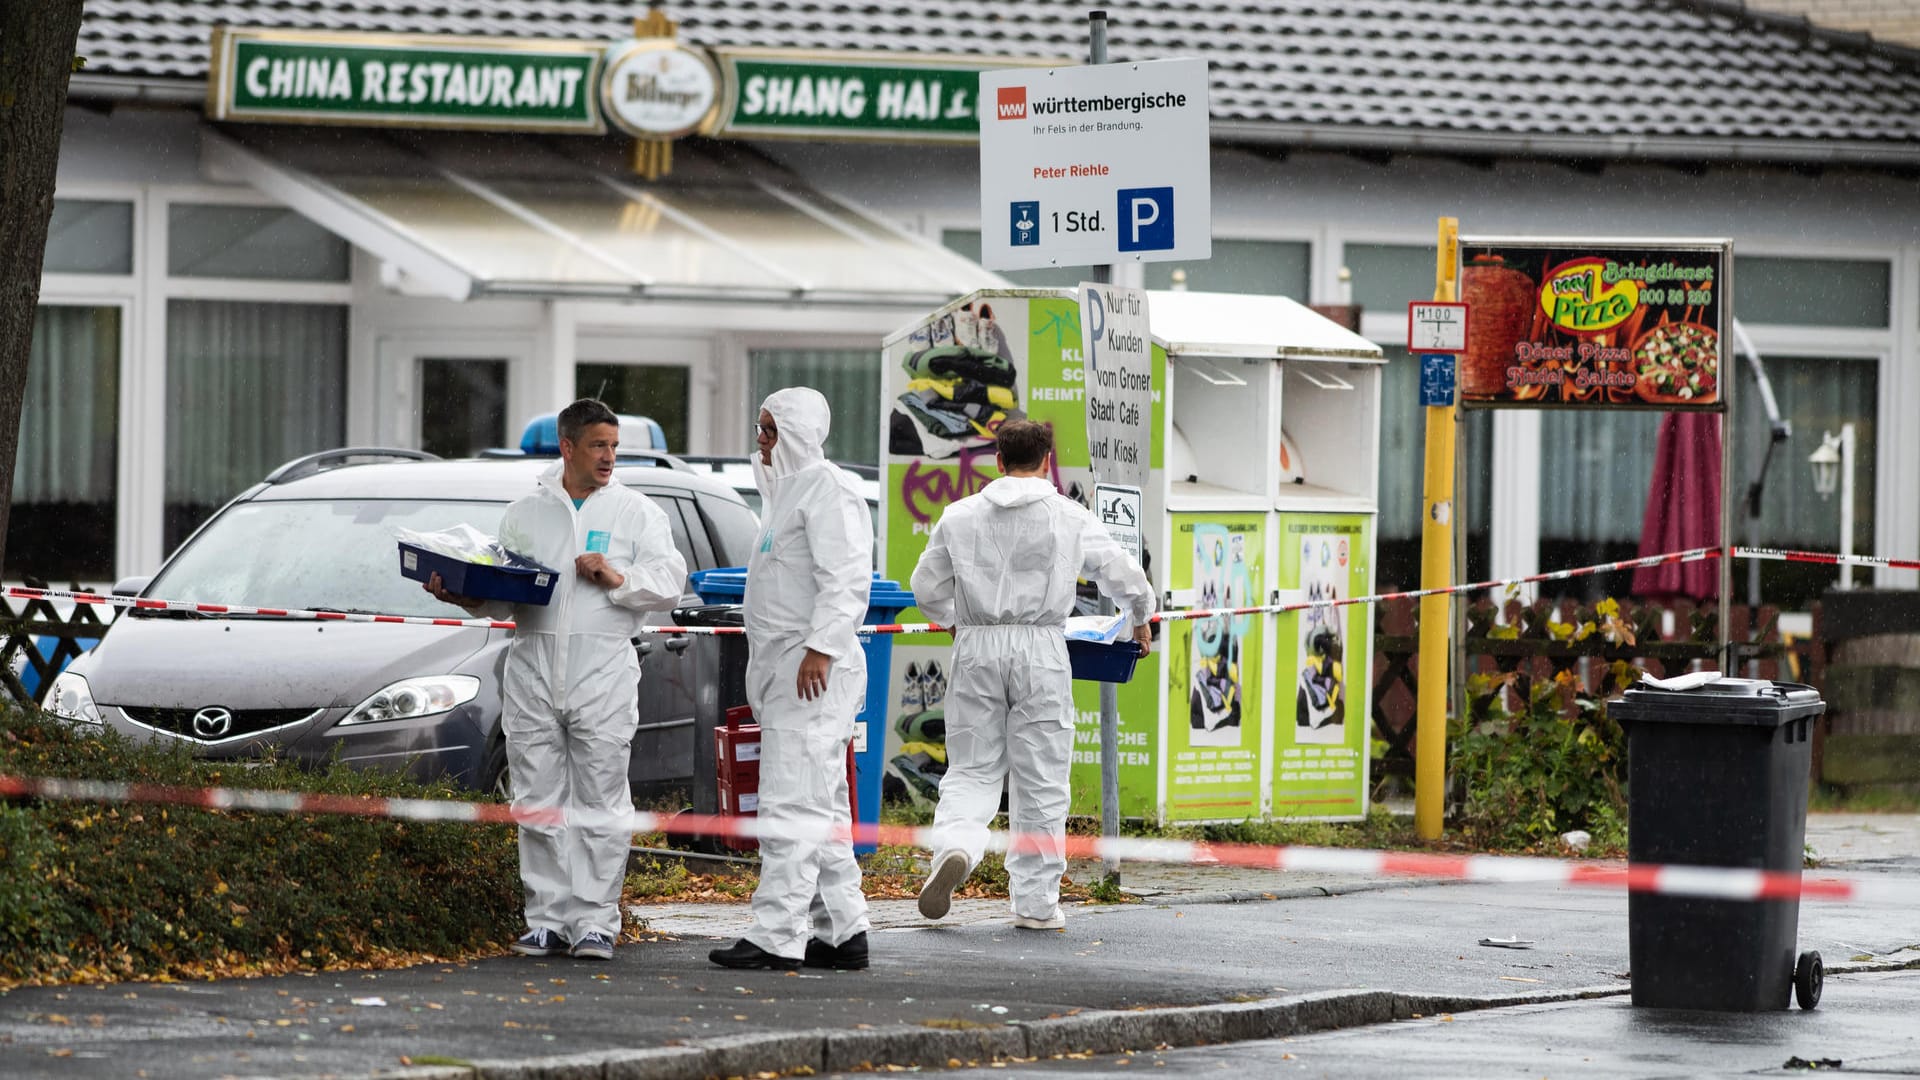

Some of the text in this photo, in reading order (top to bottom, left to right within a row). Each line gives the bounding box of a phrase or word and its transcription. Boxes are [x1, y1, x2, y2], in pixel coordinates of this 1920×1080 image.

[246, 57, 583, 107] CHINA RESTAURANT
[743, 75, 942, 120] SHANG HAI
[1033, 92, 1186, 114] württembergische
[1033, 121, 1143, 135] Ihr Fels in der Brandung.
[1033, 164, 1109, 178] Peter Riehle
[1052, 210, 1105, 233] 1 Std.
[1131, 198, 1160, 243] P
[1602, 262, 1714, 284] Bringdienst
[1552, 270, 1594, 302] my
[1106, 291, 1141, 316] Nur für
[1553, 293, 1634, 327] Pizza
[1087, 288, 1105, 371] P
[1108, 328, 1143, 353] Kunden
[1515, 342, 1631, 362] Döner Pizza
[1097, 369, 1117, 388] vom
[1120, 366, 1151, 392] Groner
[1507, 367, 1635, 388] Nudel Salate
[1090, 397, 1139, 426] Stadt Café
[1090, 437, 1138, 464] und Kiosk
